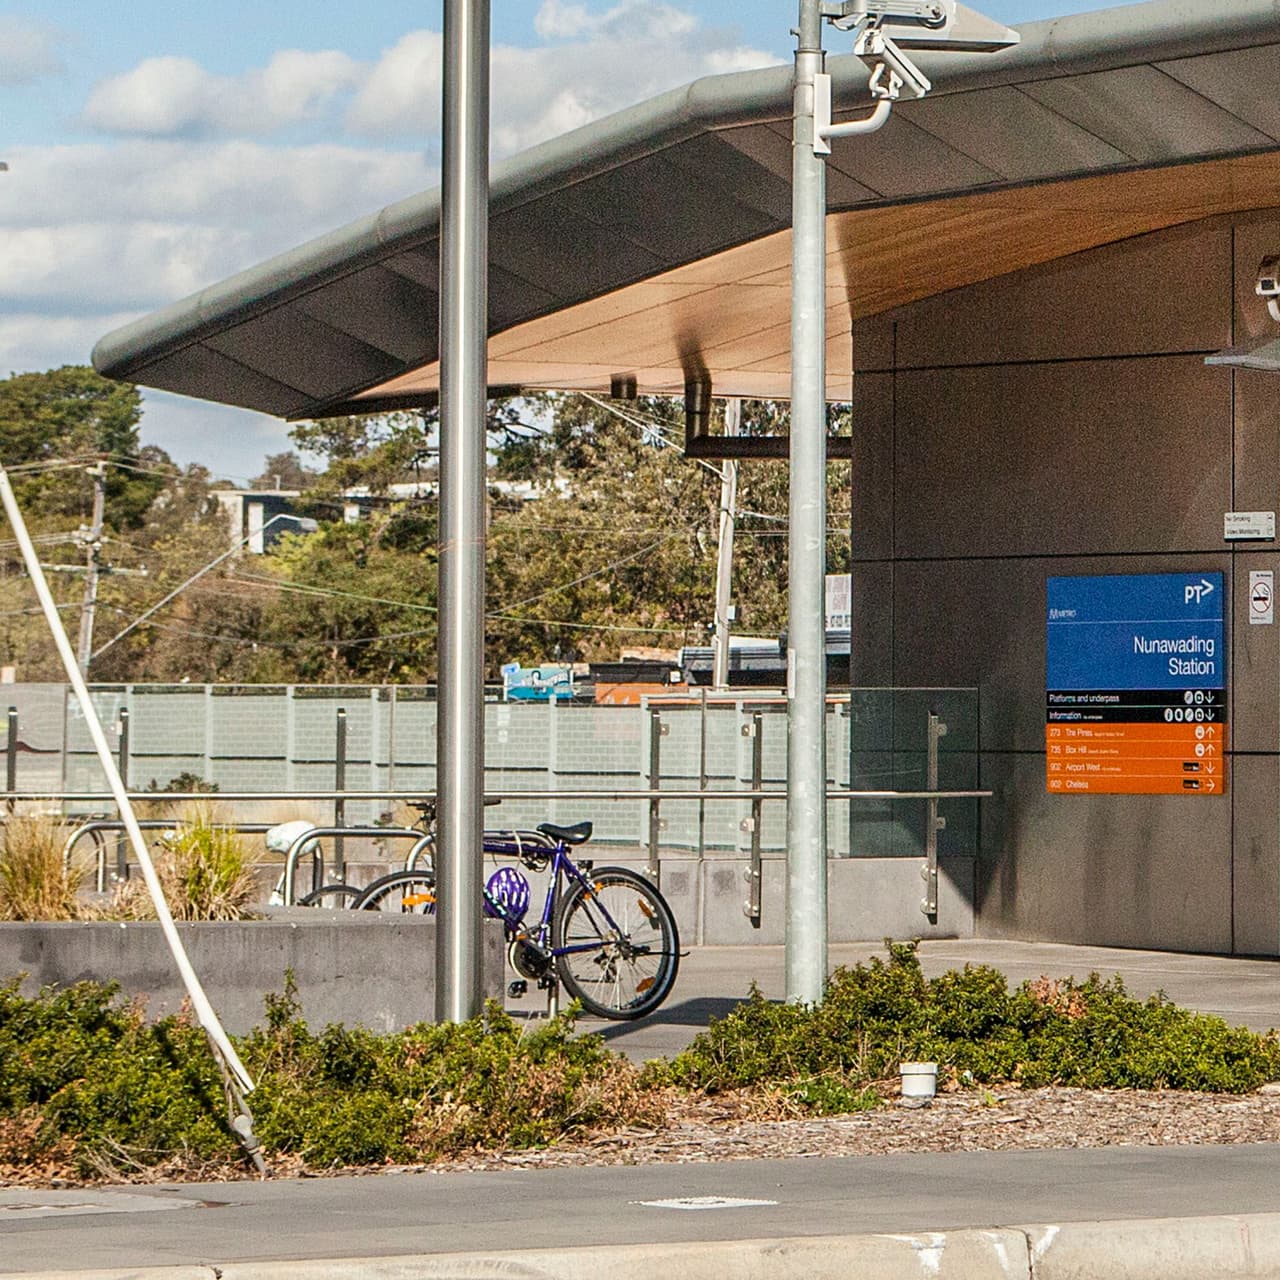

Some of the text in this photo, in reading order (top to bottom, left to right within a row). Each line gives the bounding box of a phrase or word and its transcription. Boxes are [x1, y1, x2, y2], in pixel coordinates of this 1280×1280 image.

[1134, 636, 1215, 657] Nunawading
[1168, 657, 1215, 675] Station
[1077, 693, 1088, 703] and
